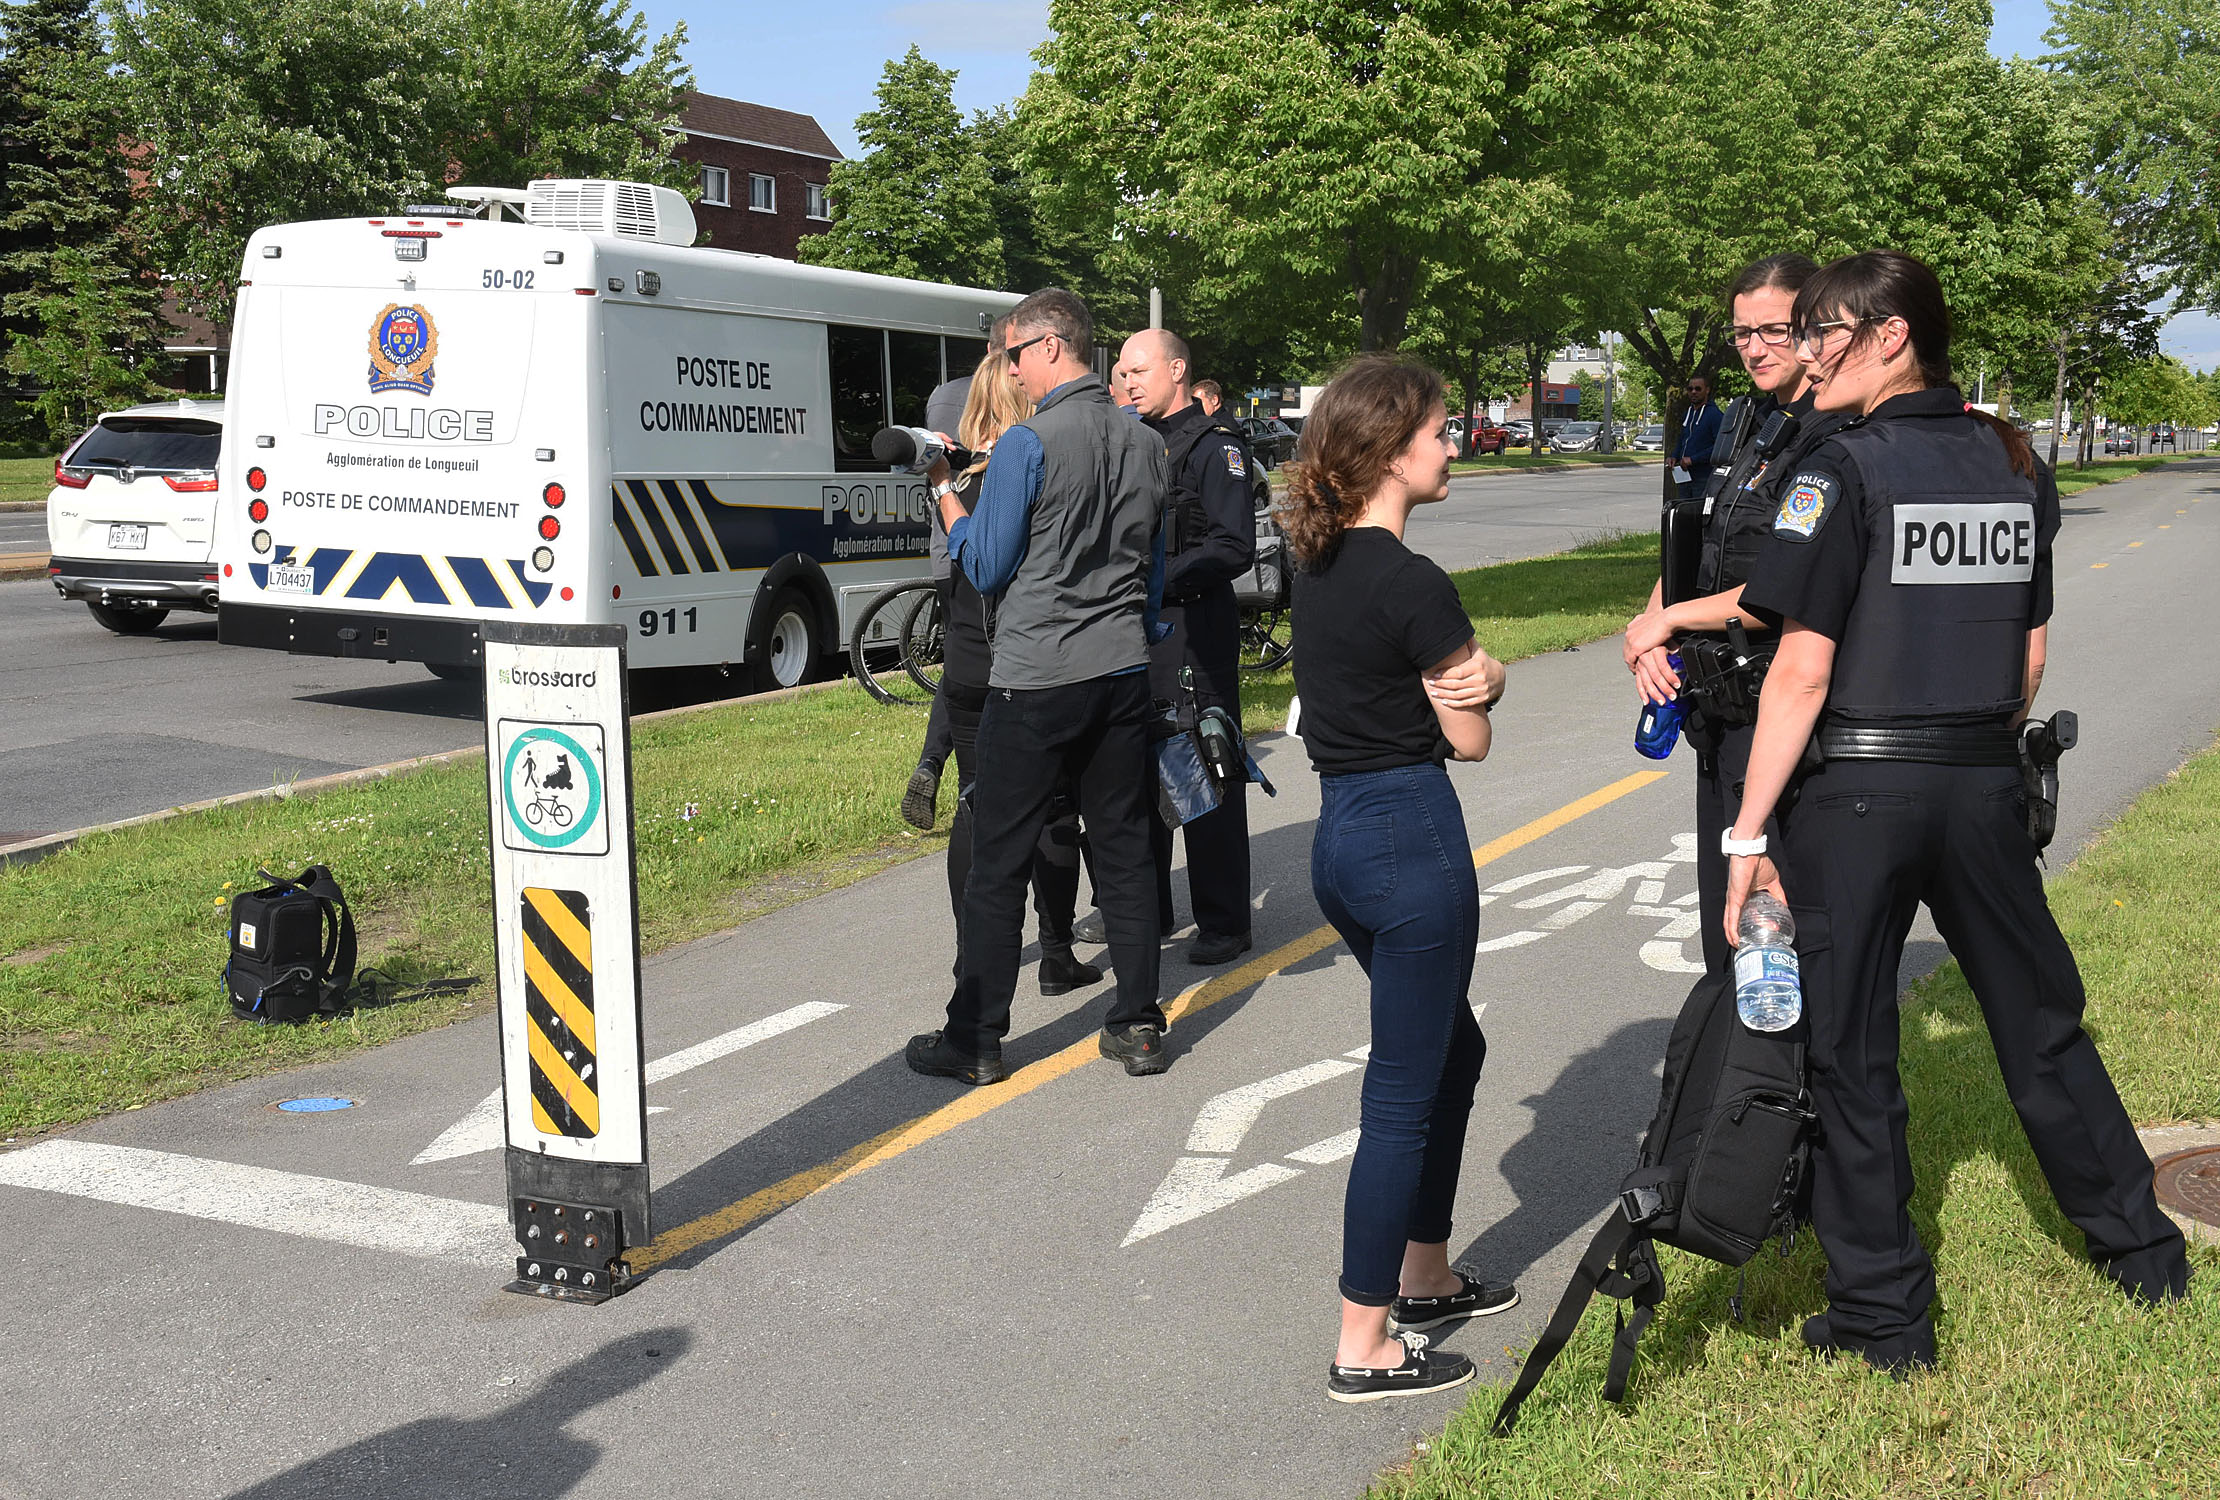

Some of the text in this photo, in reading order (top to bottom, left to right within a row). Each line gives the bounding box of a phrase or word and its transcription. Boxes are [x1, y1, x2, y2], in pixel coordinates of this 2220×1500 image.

[482, 269, 535, 289] 50-02
[390, 309, 420, 322] POLICE
[381, 343, 424, 365] LONGUEUIL
[677, 356, 771, 390] POSTE DE
[315, 404, 494, 442] POLICE
[640, 400, 807, 435] COMMANDEMENT
[327, 452, 479, 473] Agglomération de Longueuil
[1796, 475, 1831, 491] POLICE
[282, 491, 520, 519] POSTE DE COMMANDEMENT
[822, 484, 927, 525] POLIC
[111, 531, 126, 543] K67
[832, 534, 930, 558] Agglomération de Longu
[1902, 520, 2030, 567] POLICE
[269, 571, 312, 588] L704437
[639, 606, 697, 637] 911
[511, 667, 596, 688] brossard
